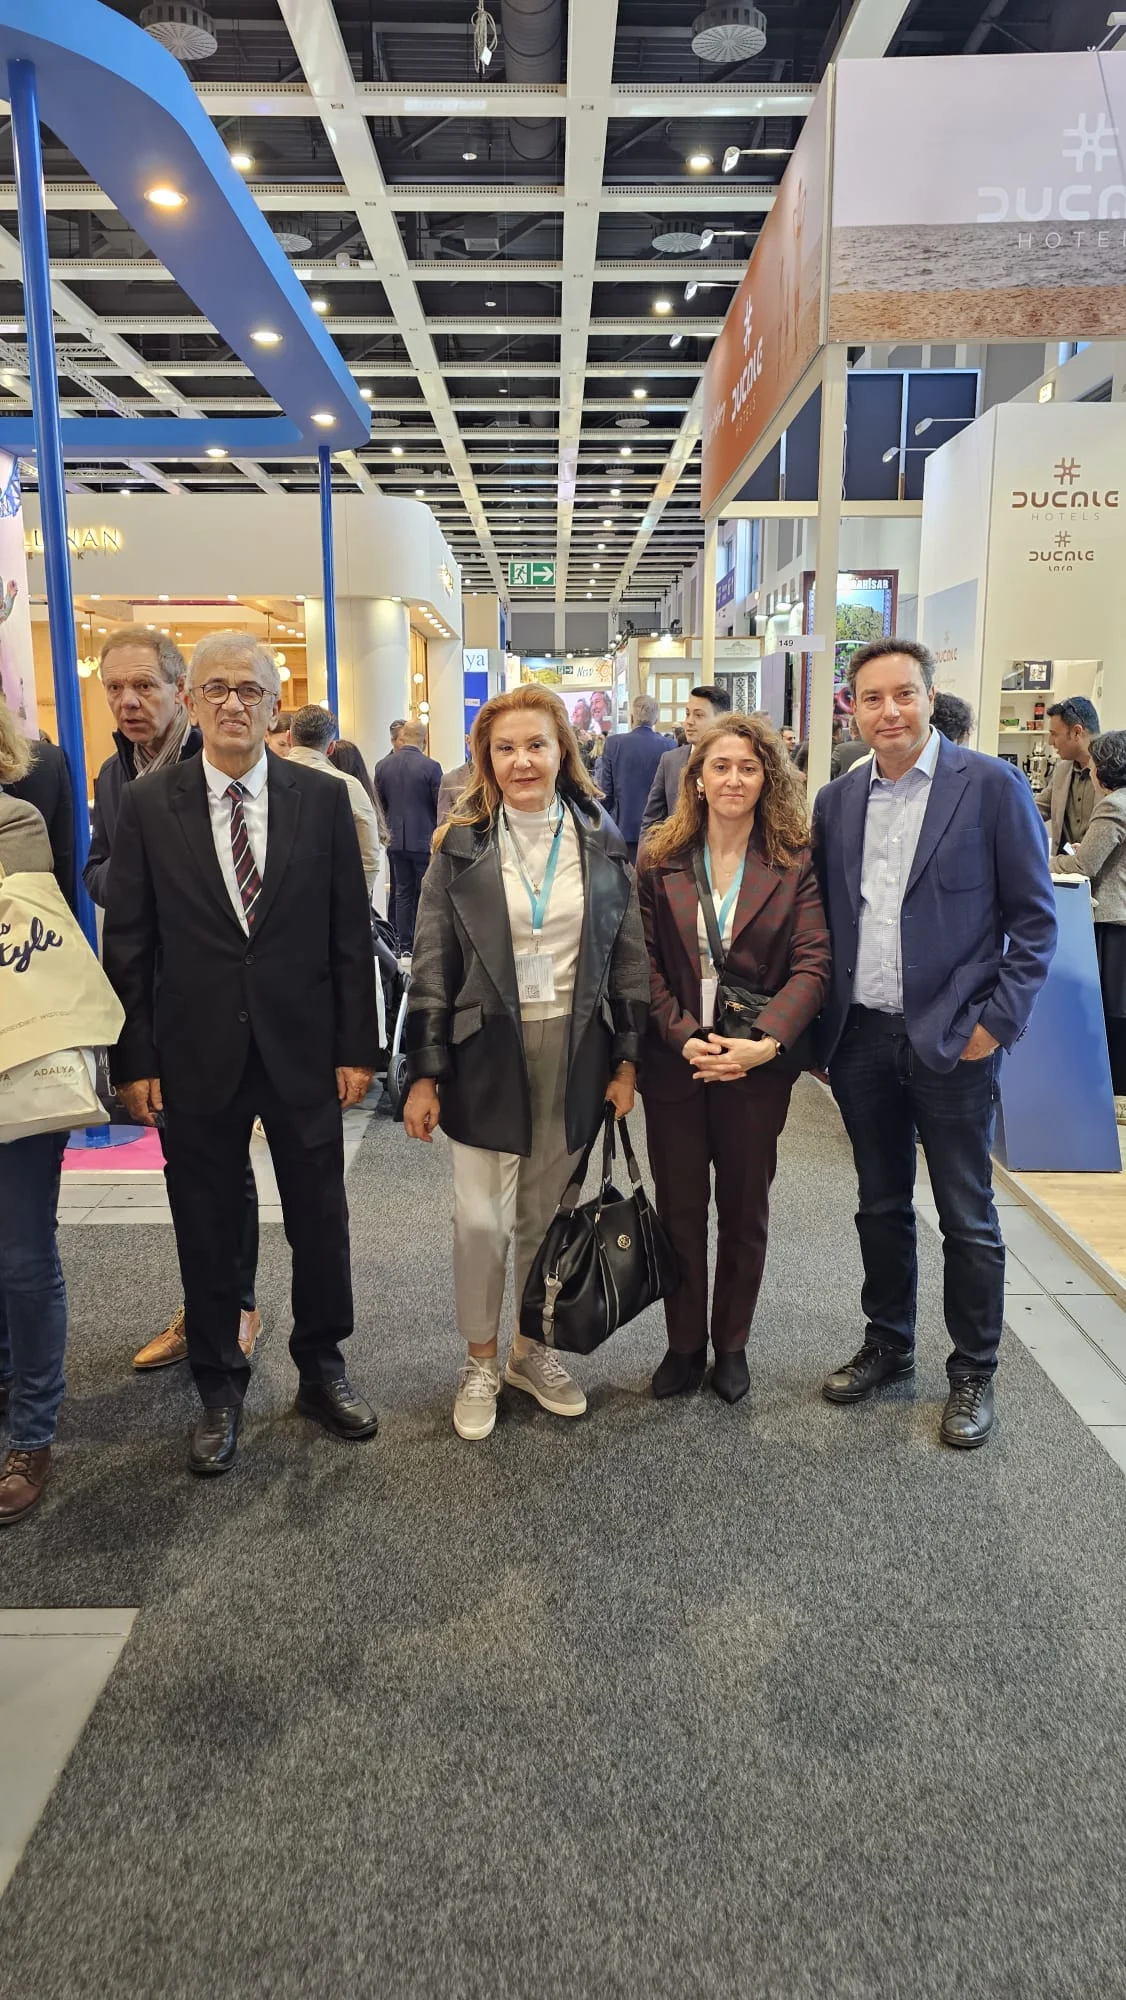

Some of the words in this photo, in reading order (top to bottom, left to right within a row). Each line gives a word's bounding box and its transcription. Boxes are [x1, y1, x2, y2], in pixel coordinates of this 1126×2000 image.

[731, 335, 763, 423] DUCALE
[1012, 490, 1119, 508] DUCALE
[1031, 512, 1100, 521] HOTELS
[1028, 550, 1095, 562] DUCALE
[778, 639, 794, 647] 149
[0, 916, 64, 973] tyle
[33, 1065, 76, 1077] ADALYA
